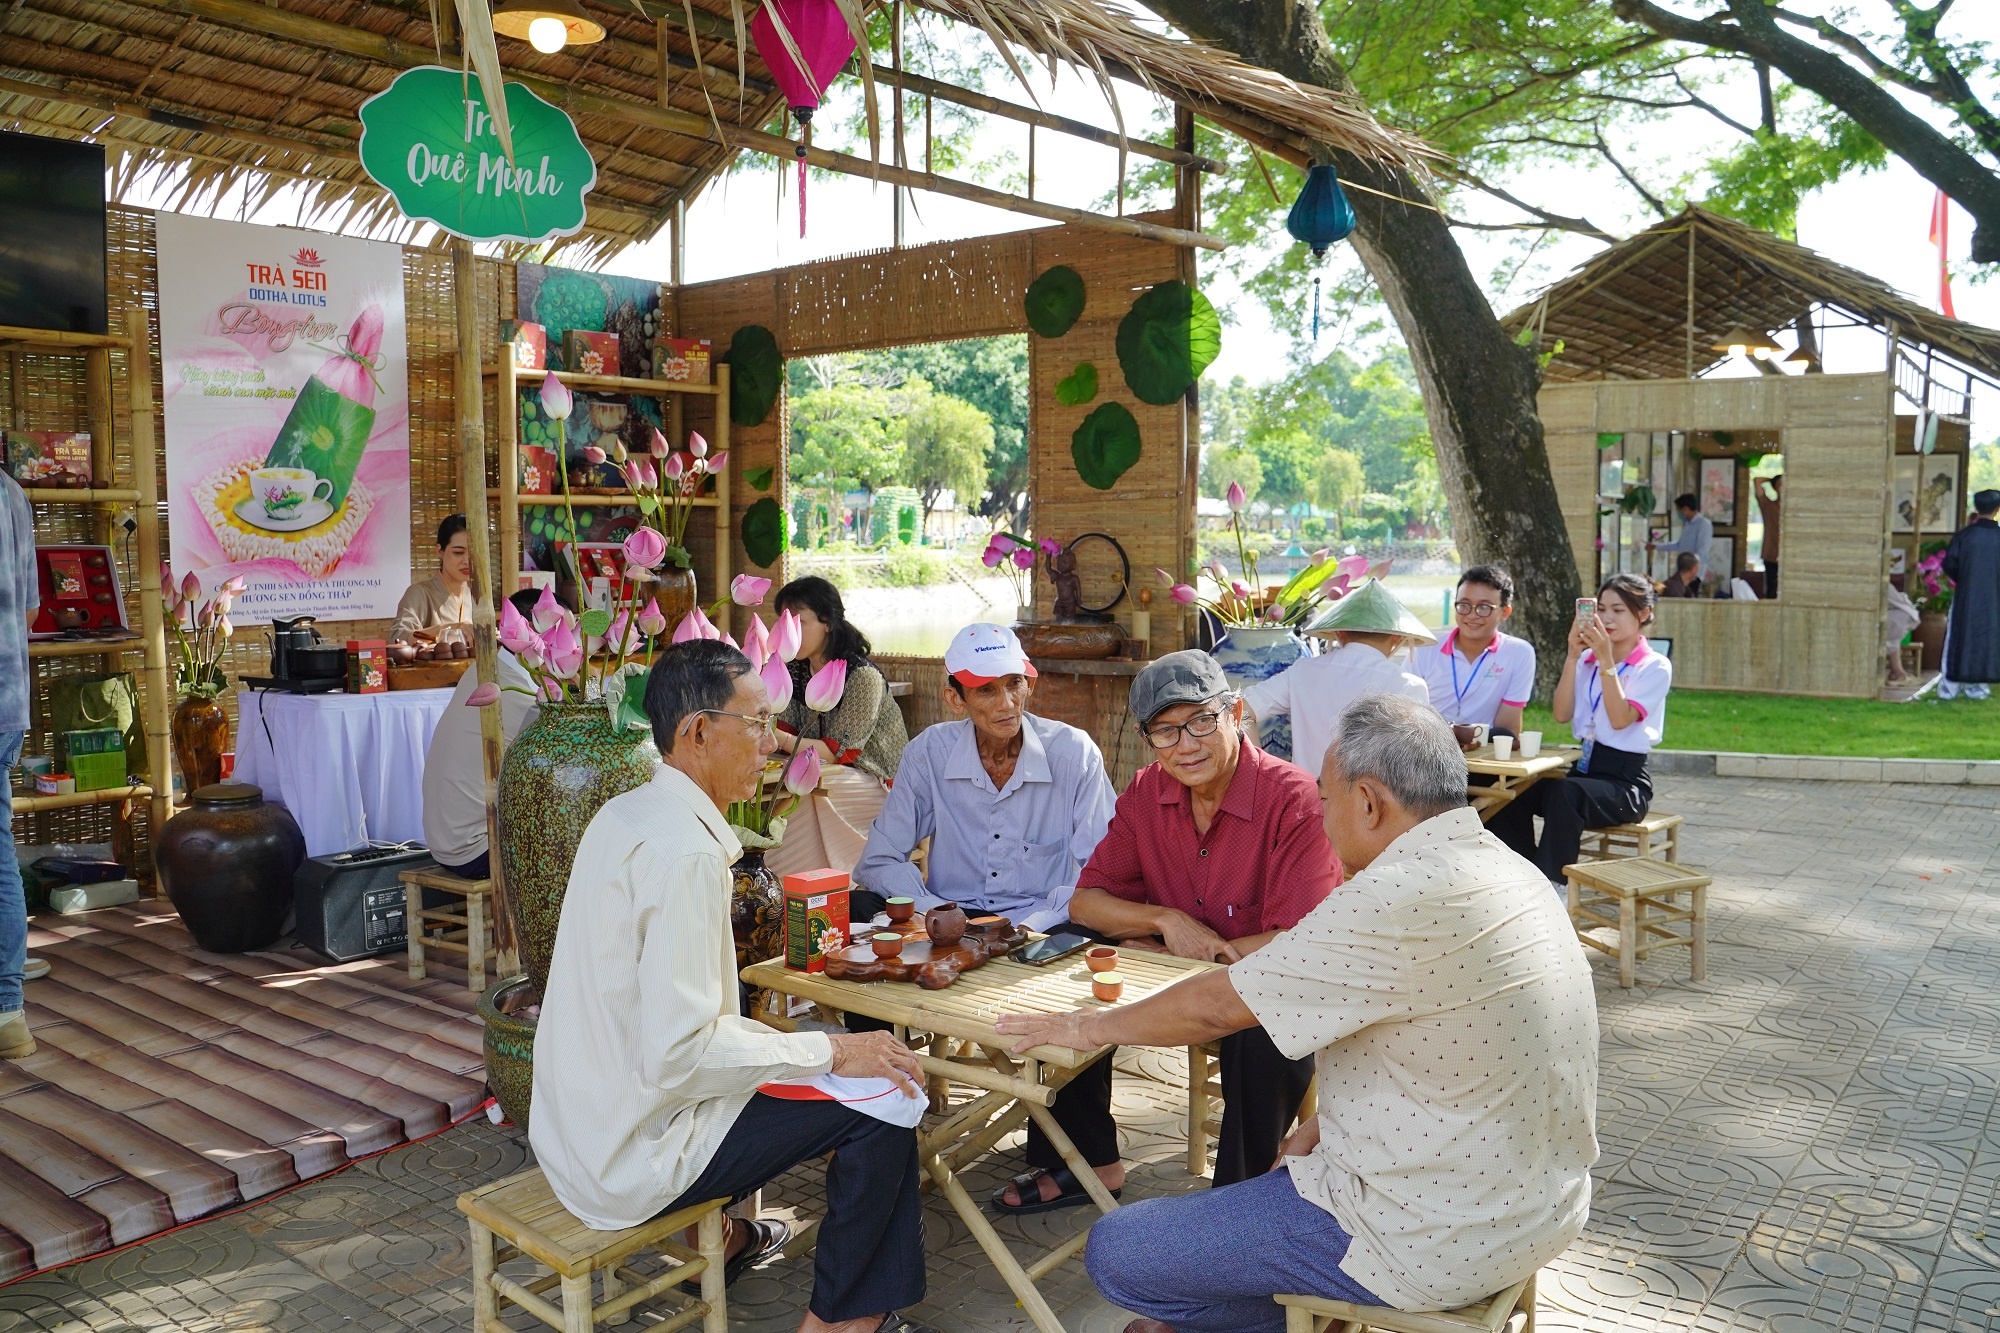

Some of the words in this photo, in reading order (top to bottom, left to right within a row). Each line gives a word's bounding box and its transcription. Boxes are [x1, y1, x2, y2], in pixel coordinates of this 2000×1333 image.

[407, 143, 469, 187] Quê
[246, 263, 286, 287] TRÀ
[292, 269, 327, 291] SEN
[249, 288, 288, 303] DOTHA
[292, 292, 327, 307] LOTUS
[72, 448, 87, 456] SEN
[254, 582, 276, 591] TNHH
[331, 579, 365, 588] THƯƠNG
[366, 578, 381, 588] MẠI
[242, 593, 277, 603] HƯƠNG
[279, 592, 297, 602] SEN
[327, 588, 352, 599] THÁP
